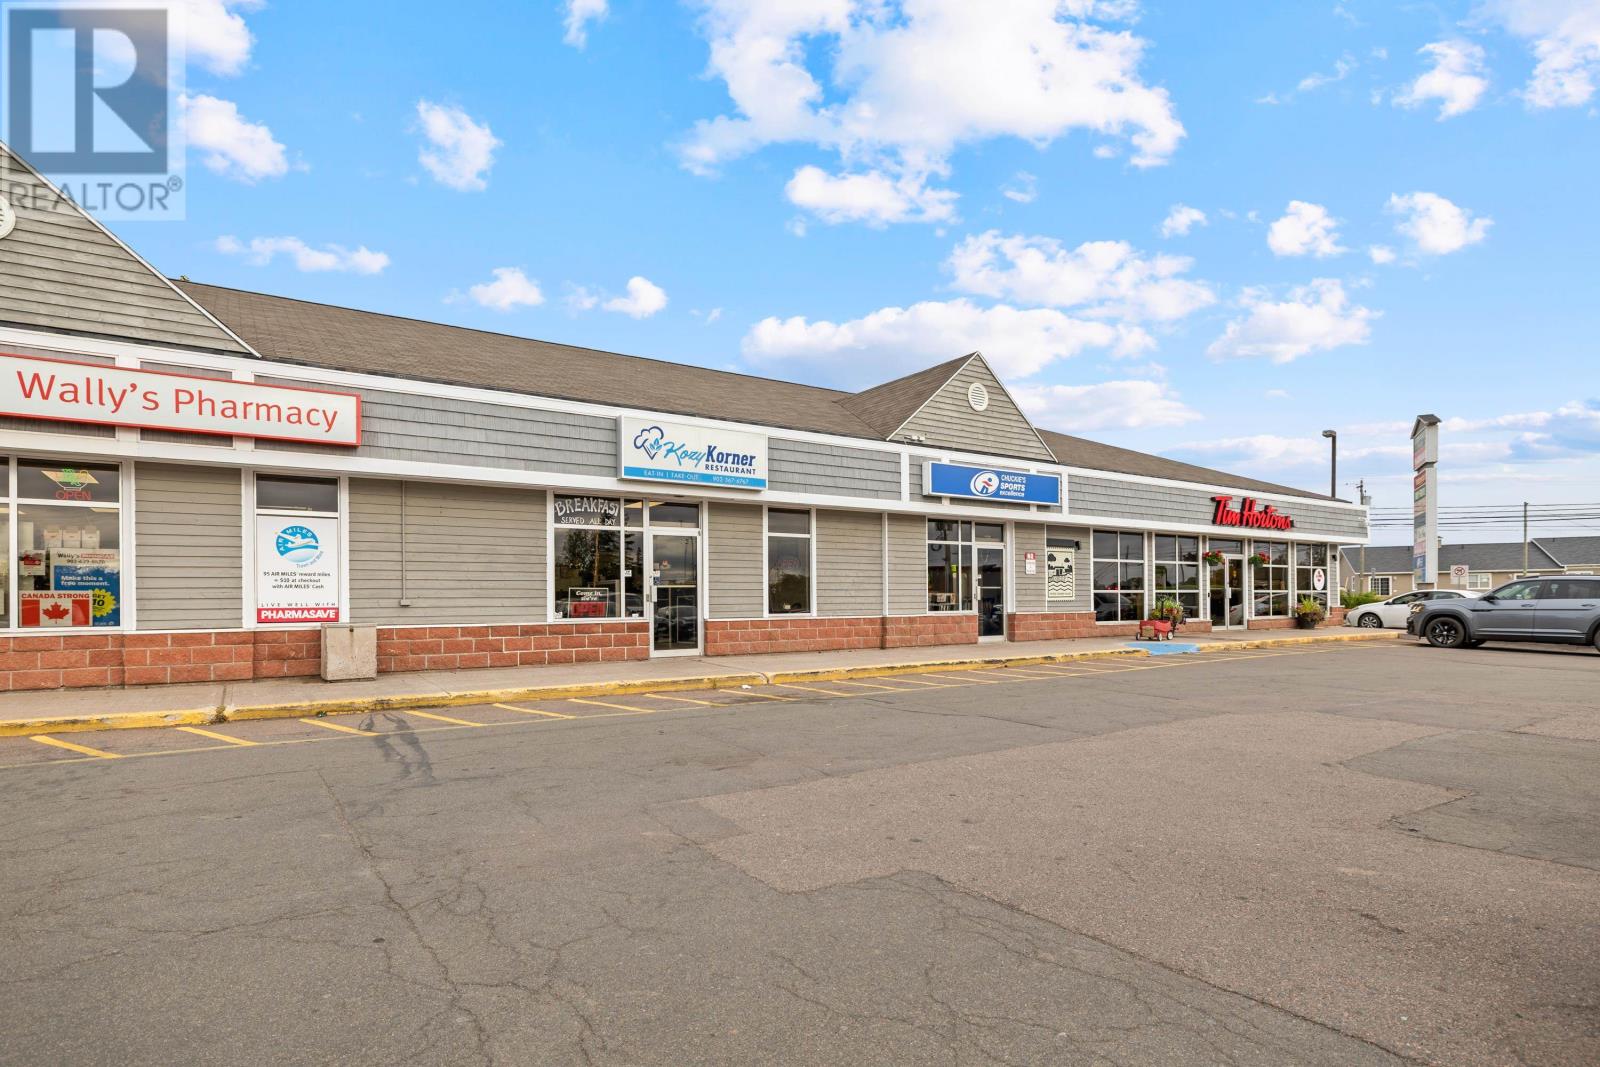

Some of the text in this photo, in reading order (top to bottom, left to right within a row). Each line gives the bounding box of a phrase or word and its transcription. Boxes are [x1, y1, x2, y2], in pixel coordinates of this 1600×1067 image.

[16, 370, 338, 433] Wally's Pharmacy
[663, 441, 756, 468] Kozy Korner
[705, 464, 756, 475] RESTAURANT
[1000, 482, 1026, 491] SPORTS
[56, 490, 92, 501] OPEN
[555, 497, 619, 517] BREAKFAST
[1210, 496, 1294, 530] Tim Hortons
[561, 516, 616, 526] SERVED ALL DAY
[286, 528, 313, 538] MILES
[261, 609, 336, 619] PHARMASAVE
